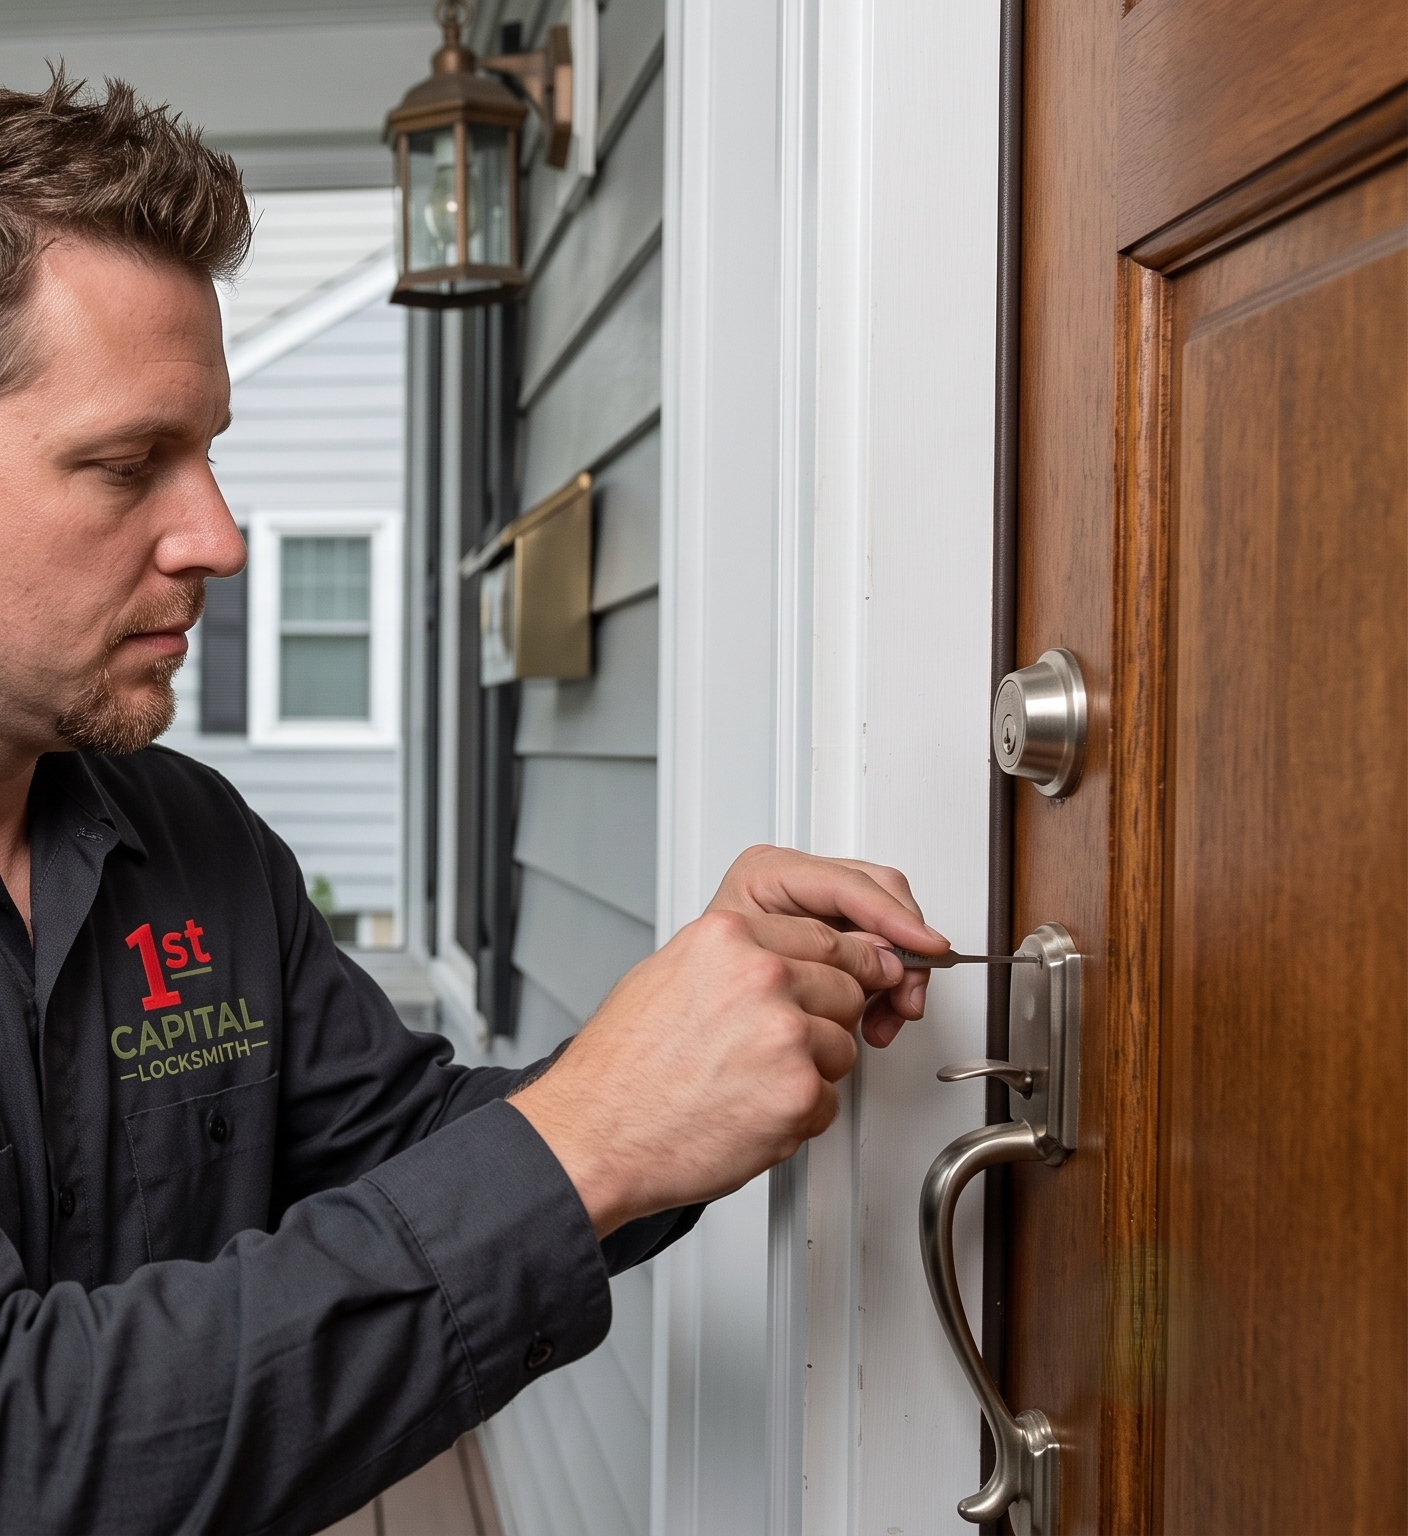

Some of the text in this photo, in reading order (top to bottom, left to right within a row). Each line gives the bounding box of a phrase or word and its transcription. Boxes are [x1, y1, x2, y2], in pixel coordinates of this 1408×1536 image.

[125, 919, 212, 1011] 1st
[111, 998, 264, 1060] CAPITAL
[138, 1039, 251, 1082] LOCKSMITH
